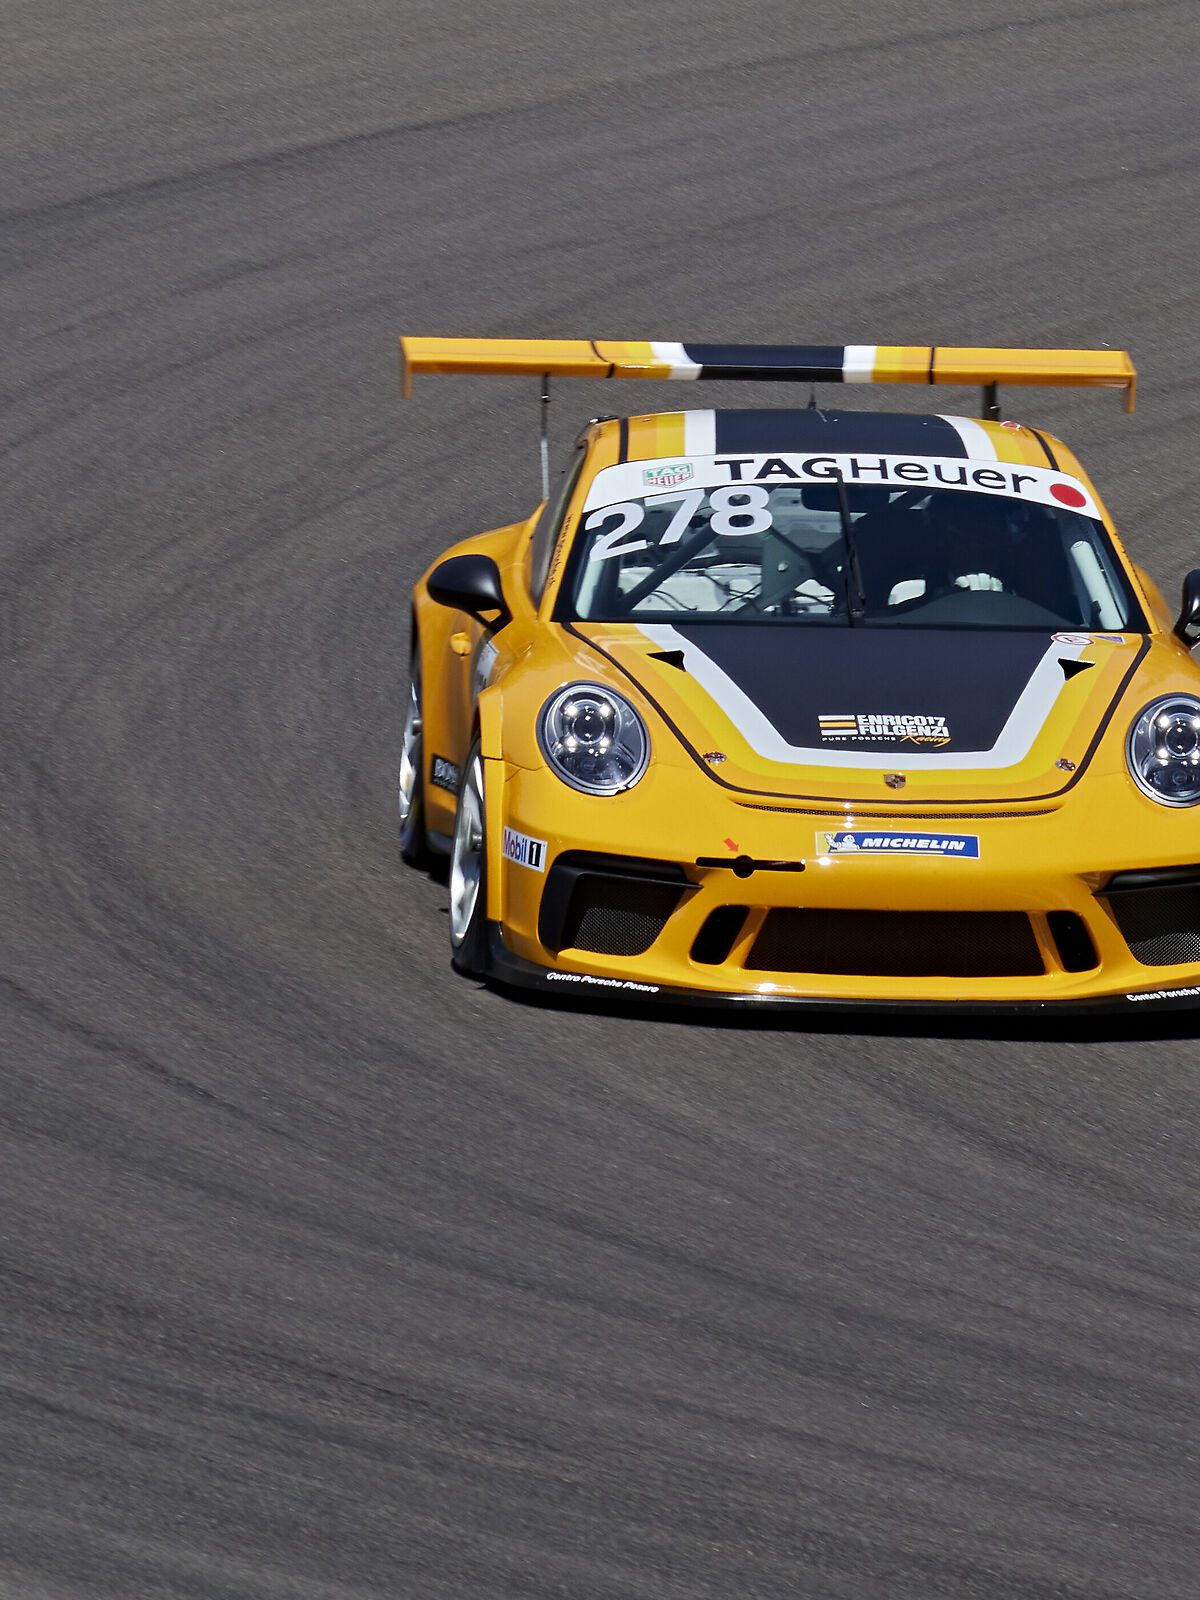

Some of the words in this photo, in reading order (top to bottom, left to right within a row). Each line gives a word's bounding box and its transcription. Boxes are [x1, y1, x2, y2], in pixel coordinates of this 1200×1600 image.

[647, 465, 689, 478] TAG
[647, 473, 692, 486] HEUER
[584, 485, 774, 562] 278
[860, 725, 950, 738] FULGENZI
[503, 829, 528, 863] Mobil
[862, 837, 966, 850] MICHELIN
[546, 972, 582, 982] Centro
[581, 975, 623, 988] Porsche
